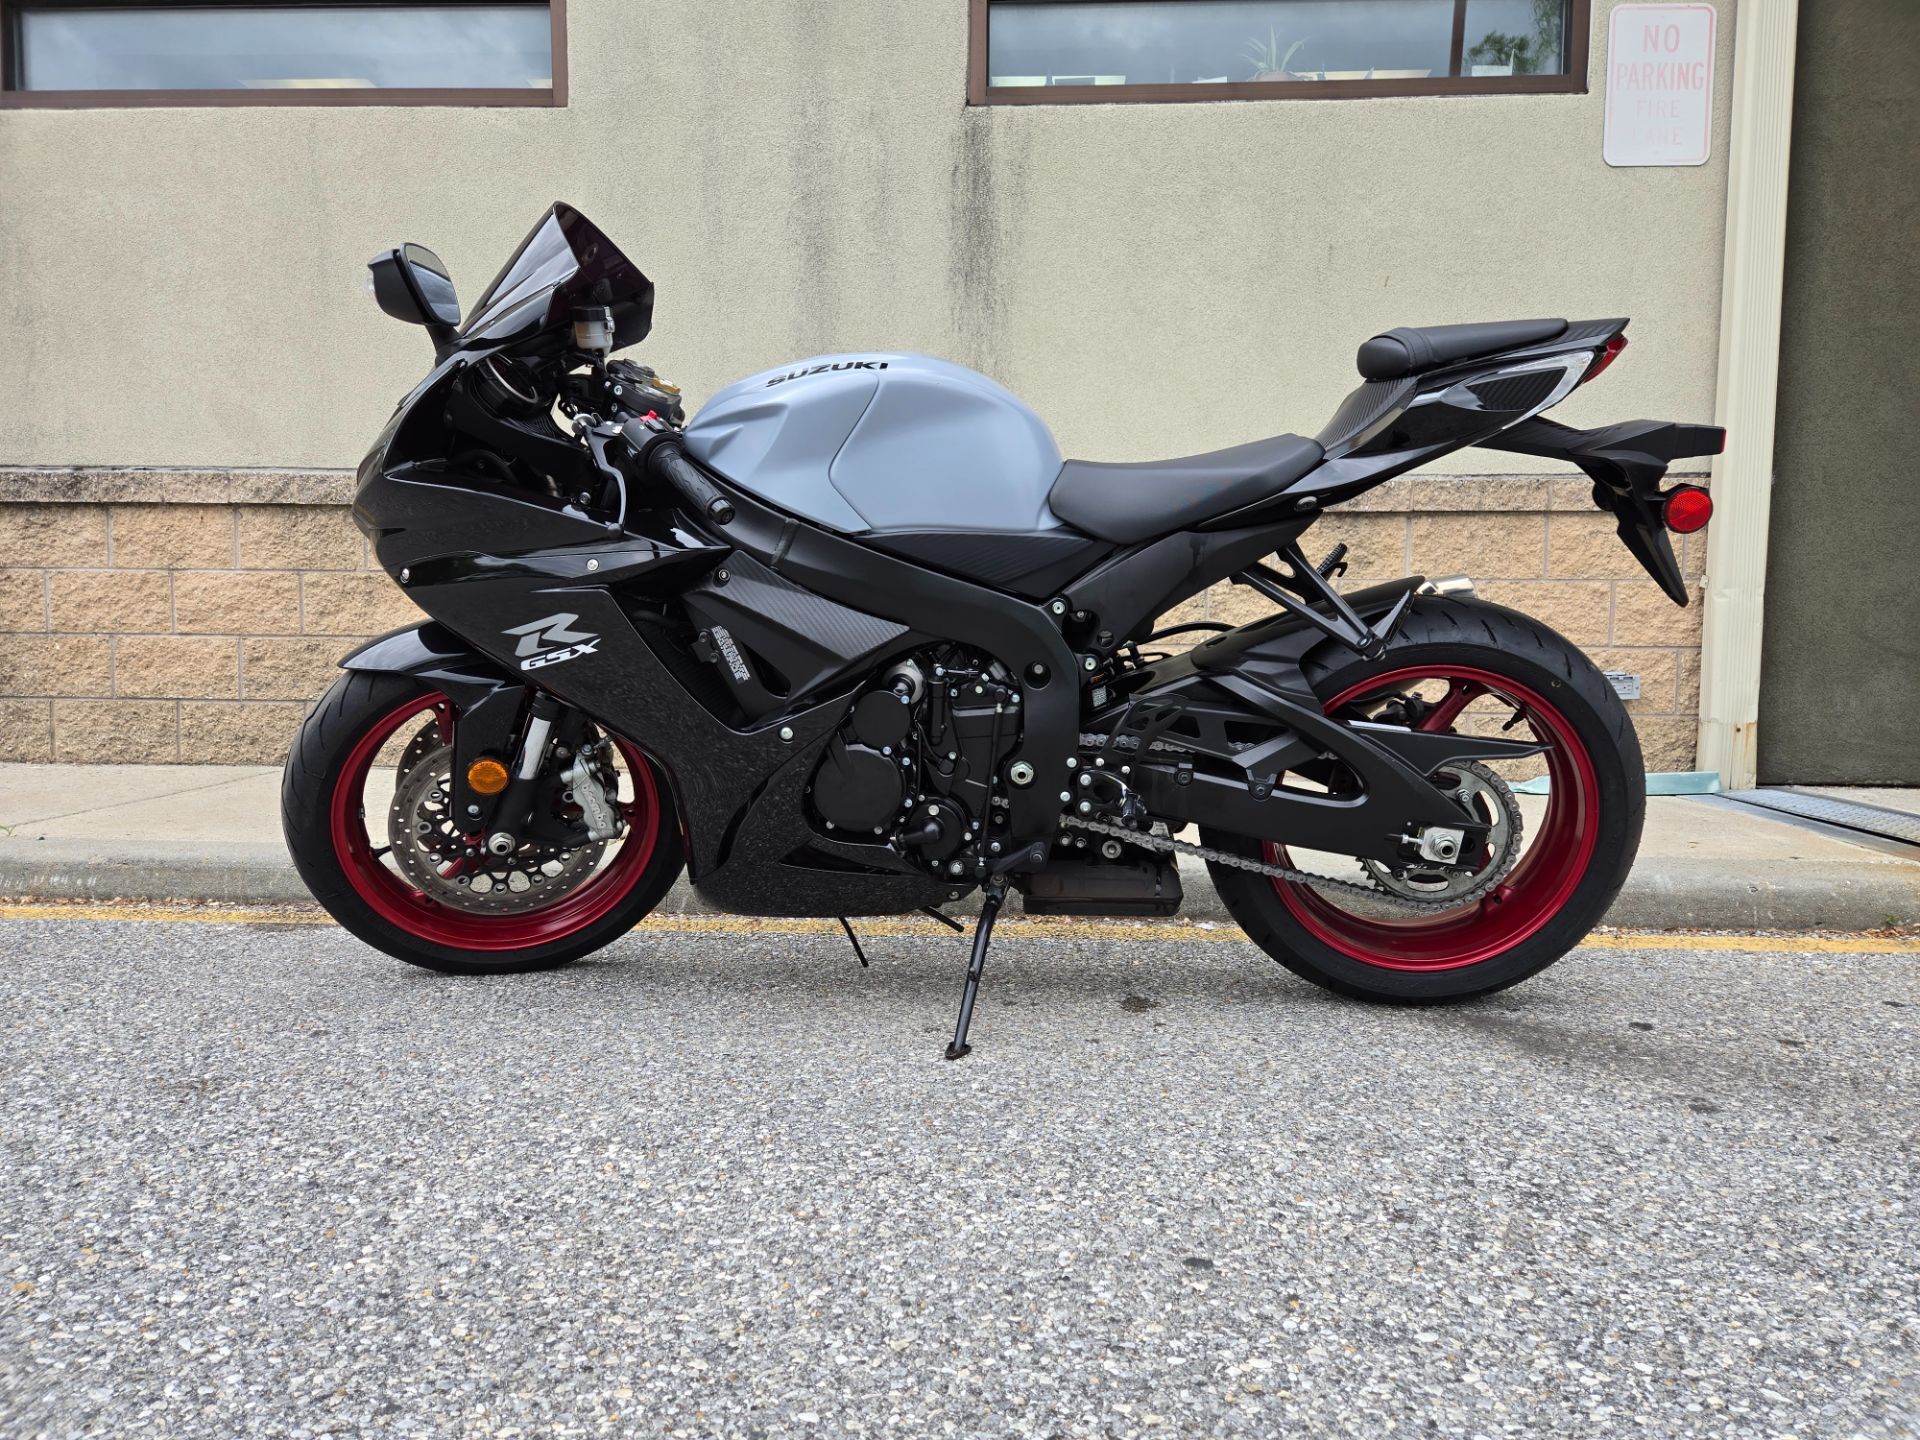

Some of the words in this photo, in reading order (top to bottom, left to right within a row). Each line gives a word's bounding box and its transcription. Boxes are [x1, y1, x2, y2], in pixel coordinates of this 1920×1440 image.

[1642, 24, 1680, 53] NO
[1616, 62, 1705, 91] PARKING
[1636, 99, 1681, 119] FIRE
[765, 361, 889, 388] SUZUKI
[520, 638, 601, 671] GSX
